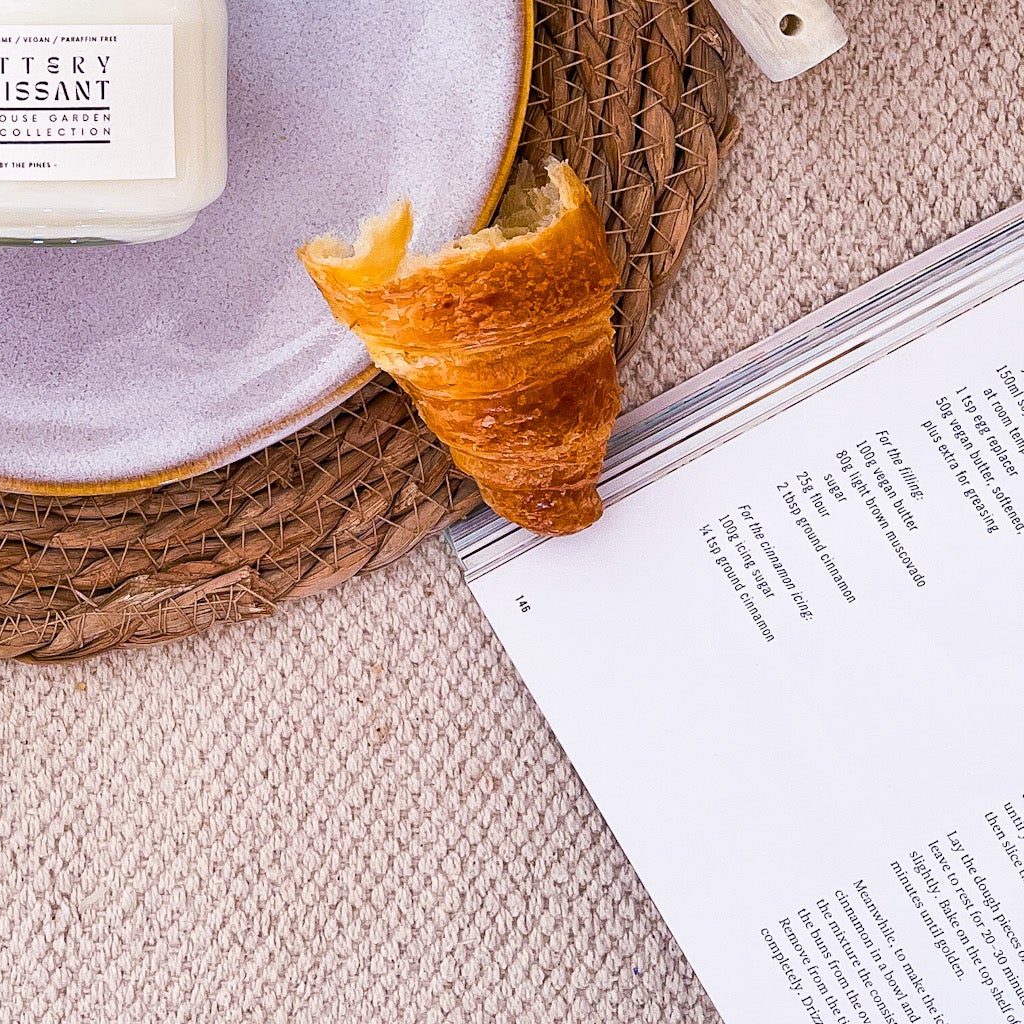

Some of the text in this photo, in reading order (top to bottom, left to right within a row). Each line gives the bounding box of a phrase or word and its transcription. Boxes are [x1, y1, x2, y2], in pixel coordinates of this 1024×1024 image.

[60, 35, 98, 43] PARAFFIN
[100, 35, 117, 43] FREE
[0, 127, 111, 137] COLLECTION
[48, 113, 111, 123] GARDEN
[11, 161, 25, 169] THE
[28, 161, 51, 169] PINES
[984, 389, 997, 400] at
[992, 401, 1012, 427] room
[996, 365, 1024, 397] 150ml
[876, 431, 923, 500] For the filling:
[921, 421, 999, 533] plus extra for greasing
[936, 397, 1024, 534] 50g vegan butter, softened,
[962, 395, 976, 413] tsp
[974, 415, 990, 435] egg
[987, 436, 1018, 476] replacer
[797, 472, 830, 517] 25g flour
[824, 474, 847, 502] sugar
[836, 450, 925, 587] 80g light brown muscovado
[857, 440, 918, 531] 100g vegan butter
[719, 515, 774, 597] 100g icing sugar
[738, 505, 813, 620] For the cinnamon icing:
[777, 482, 855, 603] 2 tbsp ground cinnamon
[515, 595, 531, 613] 146
[707, 536, 721, 554] tsp
[716, 557, 745, 591] ground
[740, 593, 774, 642] cinnamon
[928, 840, 950, 871] leave
[948, 873, 958, 885] to
[956, 888, 974, 910] rest
[970, 911, 985, 927] for
[985, 812, 1022, 867] then slice
[891, 861, 964, 981] minutes until golden.
[910, 851, 940, 898] slightly.
[939, 899, 959, 928] Bake
[957, 930, 969, 945] on
[966, 946, 981, 965] the
[979, 966, 993, 985] top
[991, 987, 1014, 1013] shelf
[947, 831, 1021, 949] Lay the dough pieces
[761, 929, 803, 995] completely.
[779, 918, 810, 964] Remove
[807, 966, 828, 995] from
[825, 996, 840, 1015] the
[798, 909, 813, 929] the
[811, 929, 831, 959] buns
[828, 960, 849, 989] from
[846, 990, 861, 1009] the
[817, 899, 897, 1024] the mixture the consis
[835, 891, 873, 948] cinnamon
[870, 948, 881, 962] in
[884, 970, 907, 1000] bowl
[901, 1002, 921, 1023] and
[853, 880, 895, 947] Meanwhile,
[895, 949, 905, 961] to
[903, 963, 925, 993] make
[922, 995, 937, 1014] the
